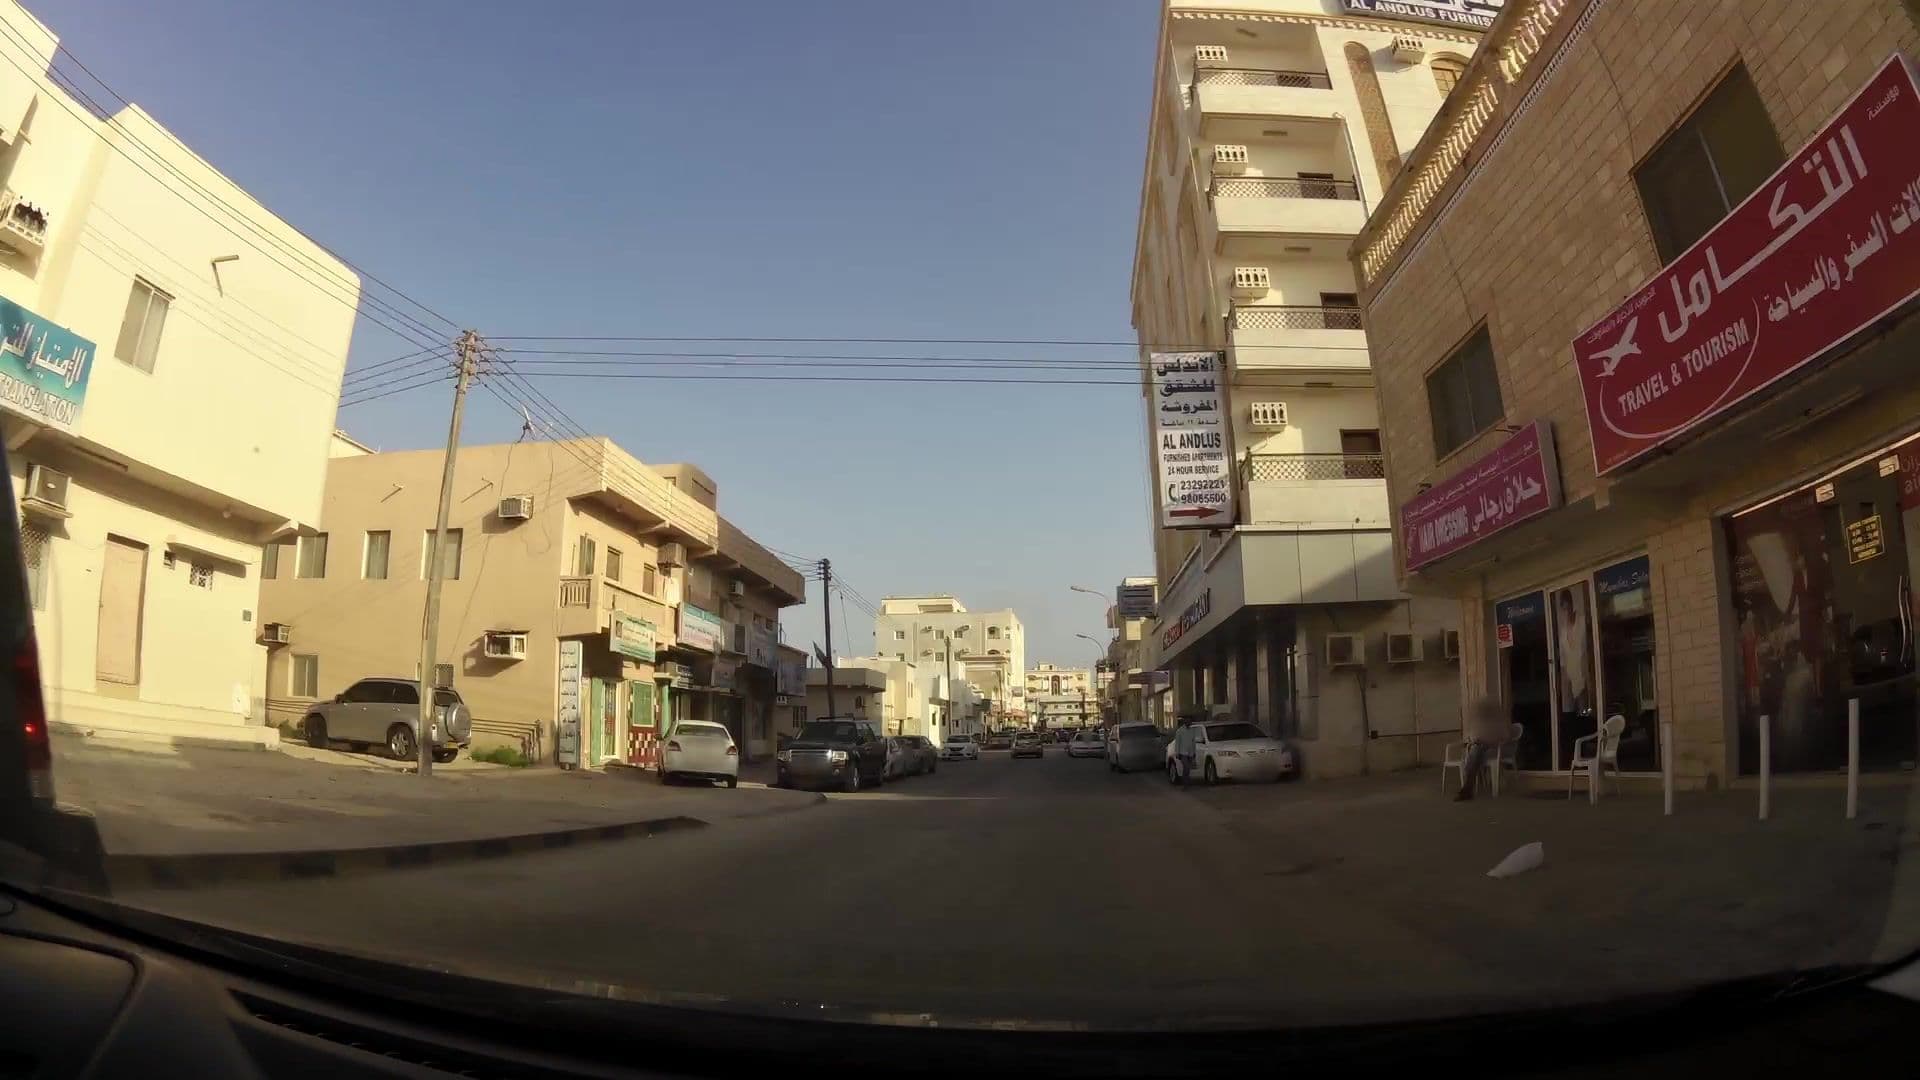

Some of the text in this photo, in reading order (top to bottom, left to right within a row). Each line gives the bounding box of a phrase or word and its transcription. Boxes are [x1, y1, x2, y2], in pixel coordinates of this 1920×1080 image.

[1375, 0, 1437, 19] ANDLUS
[1439, 8, 1494, 28] FURNIS
[1844, 210, 1889, 281] السفر
[1763, 255, 1841, 322] والسياحة
[1618, 317, 1750, 417] TRAVEL & TOURISM
[1163, 432, 1221, 450] AL ANDLUS
[1168, 464, 1220, 476] 24 HOUR SERVICE
[1503, 472, 1542, 514] حلاق
[1471, 493, 1504, 537] رجالي
